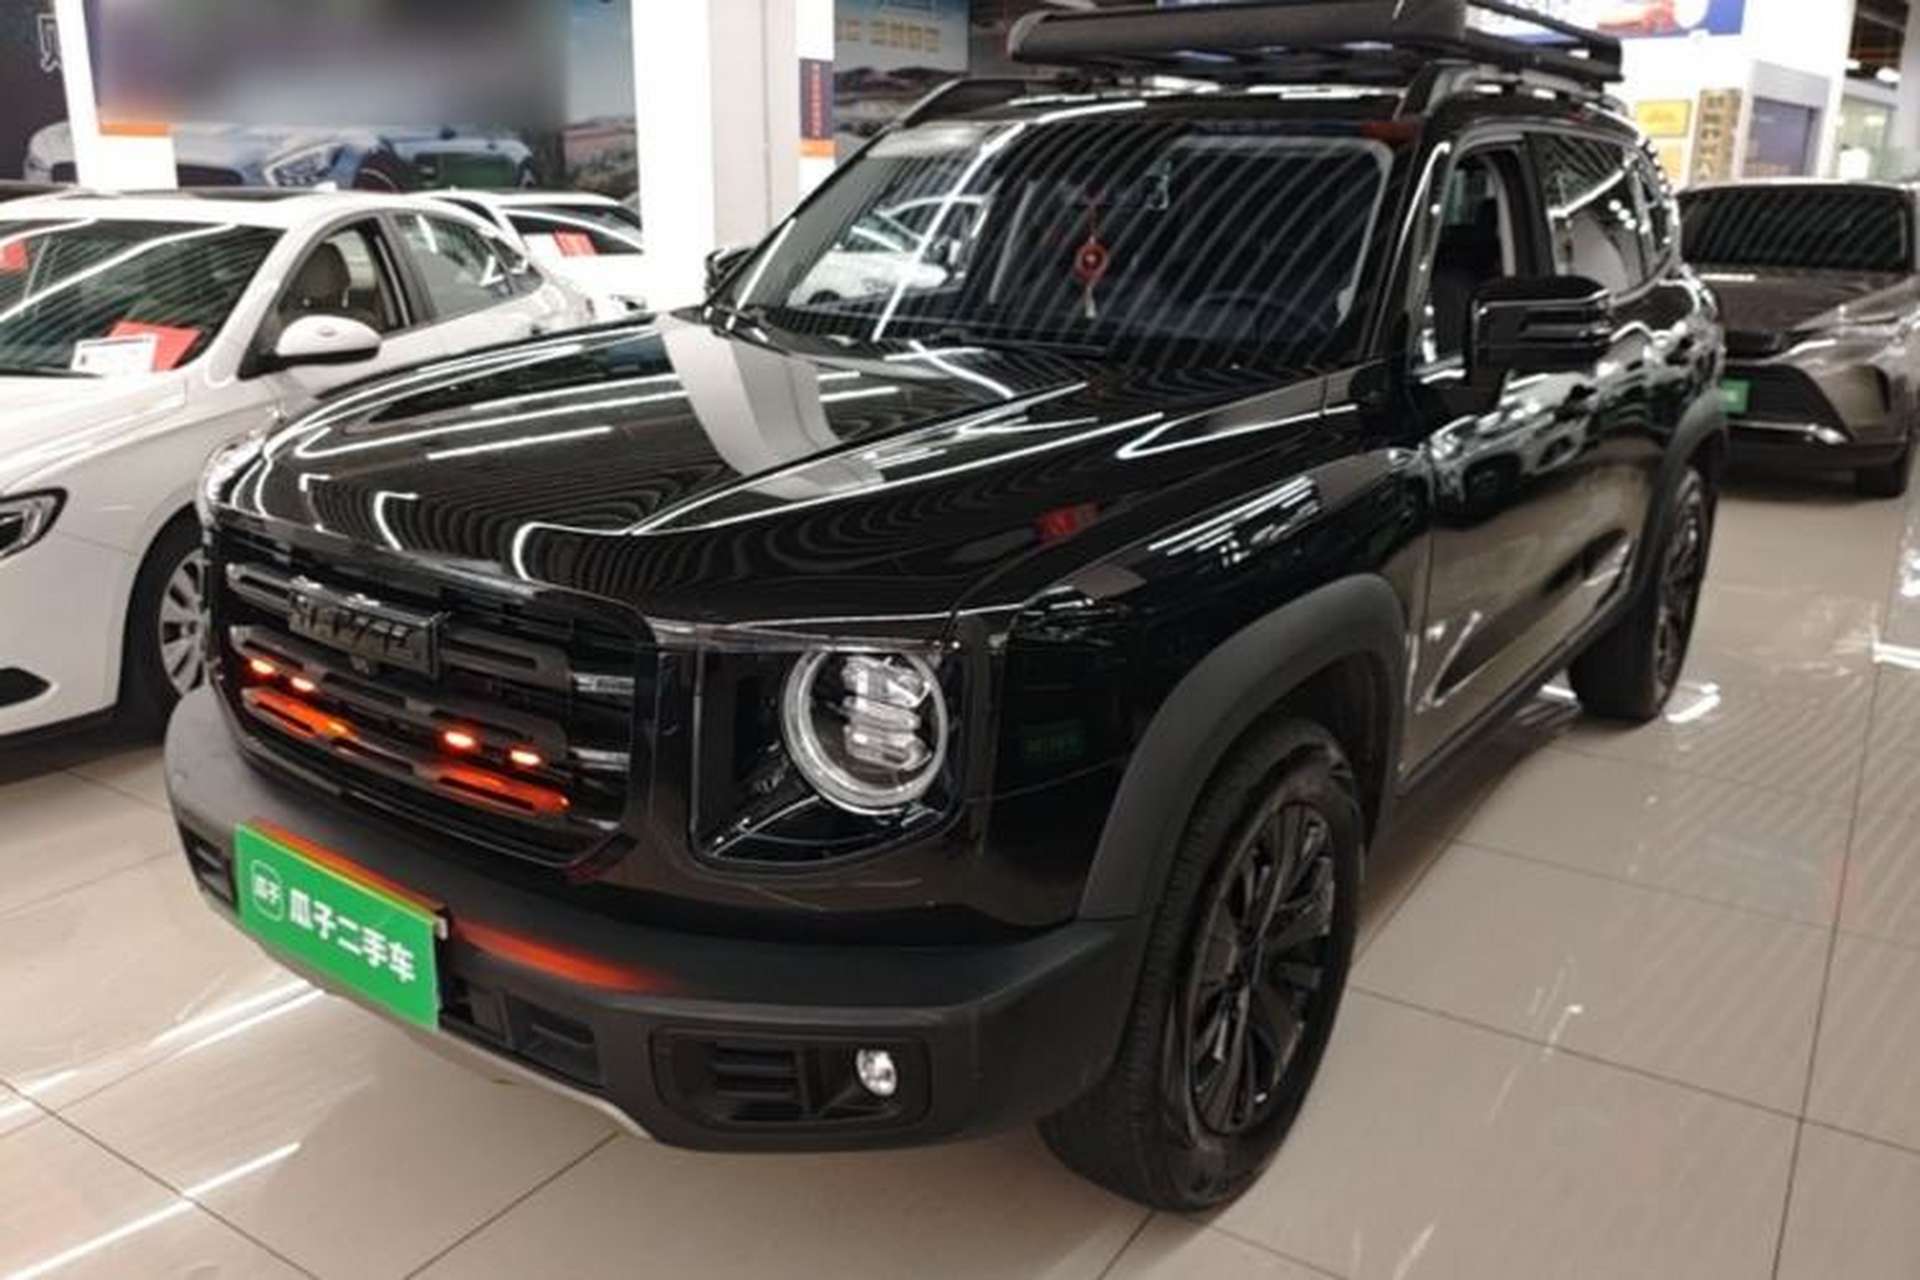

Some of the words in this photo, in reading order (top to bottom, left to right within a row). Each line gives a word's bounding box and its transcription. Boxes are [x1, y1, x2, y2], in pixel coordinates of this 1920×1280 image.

[290, 888, 415, 983] 瓜子二手车
